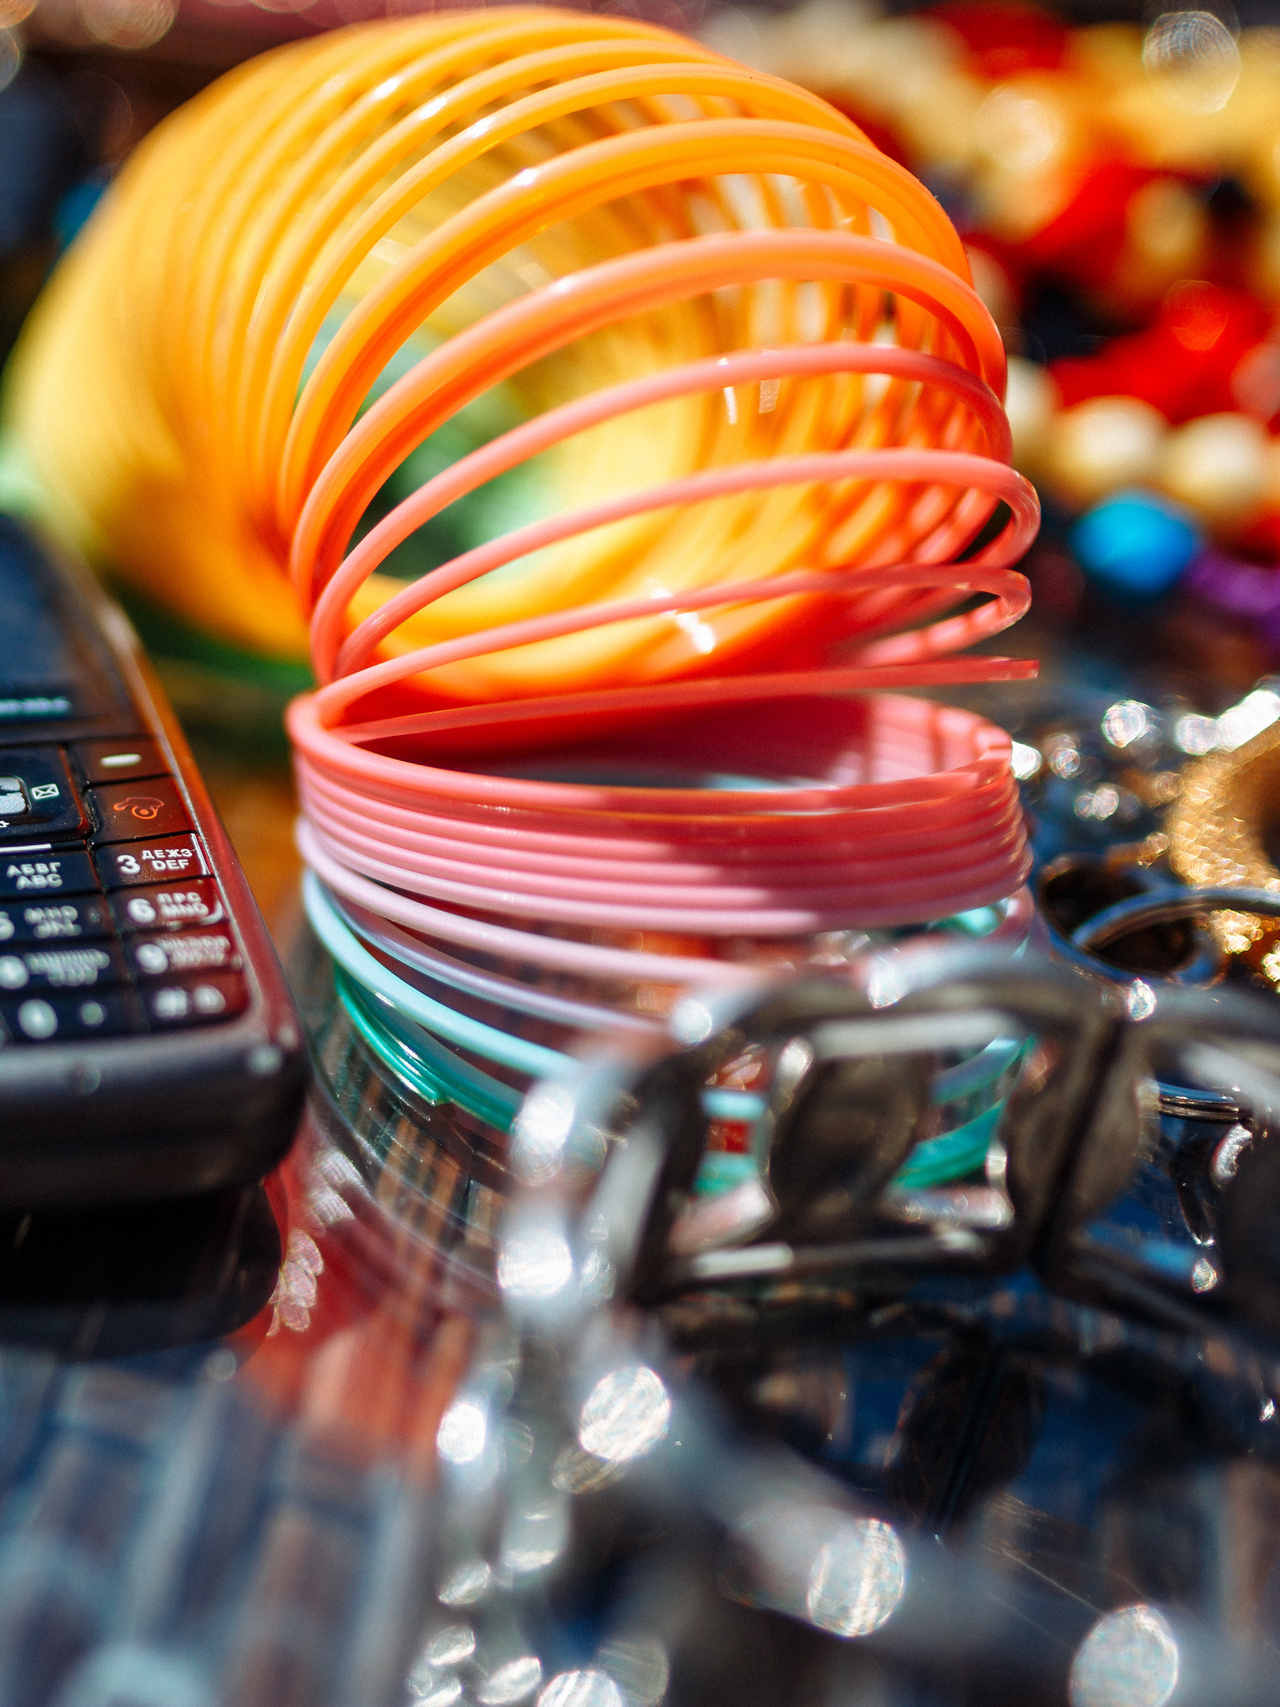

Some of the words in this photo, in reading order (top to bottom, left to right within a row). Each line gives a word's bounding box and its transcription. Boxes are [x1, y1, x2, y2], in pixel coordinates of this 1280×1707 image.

[6, 861, 62, 879] АБВГ
[117, 854, 141, 875] 3
[141, 848, 193, 861] ДЕЖЗ
[152, 858, 190, 871] DEF
[16, 873, 63, 890] ABC
[127, 897, 157, 924] 6
